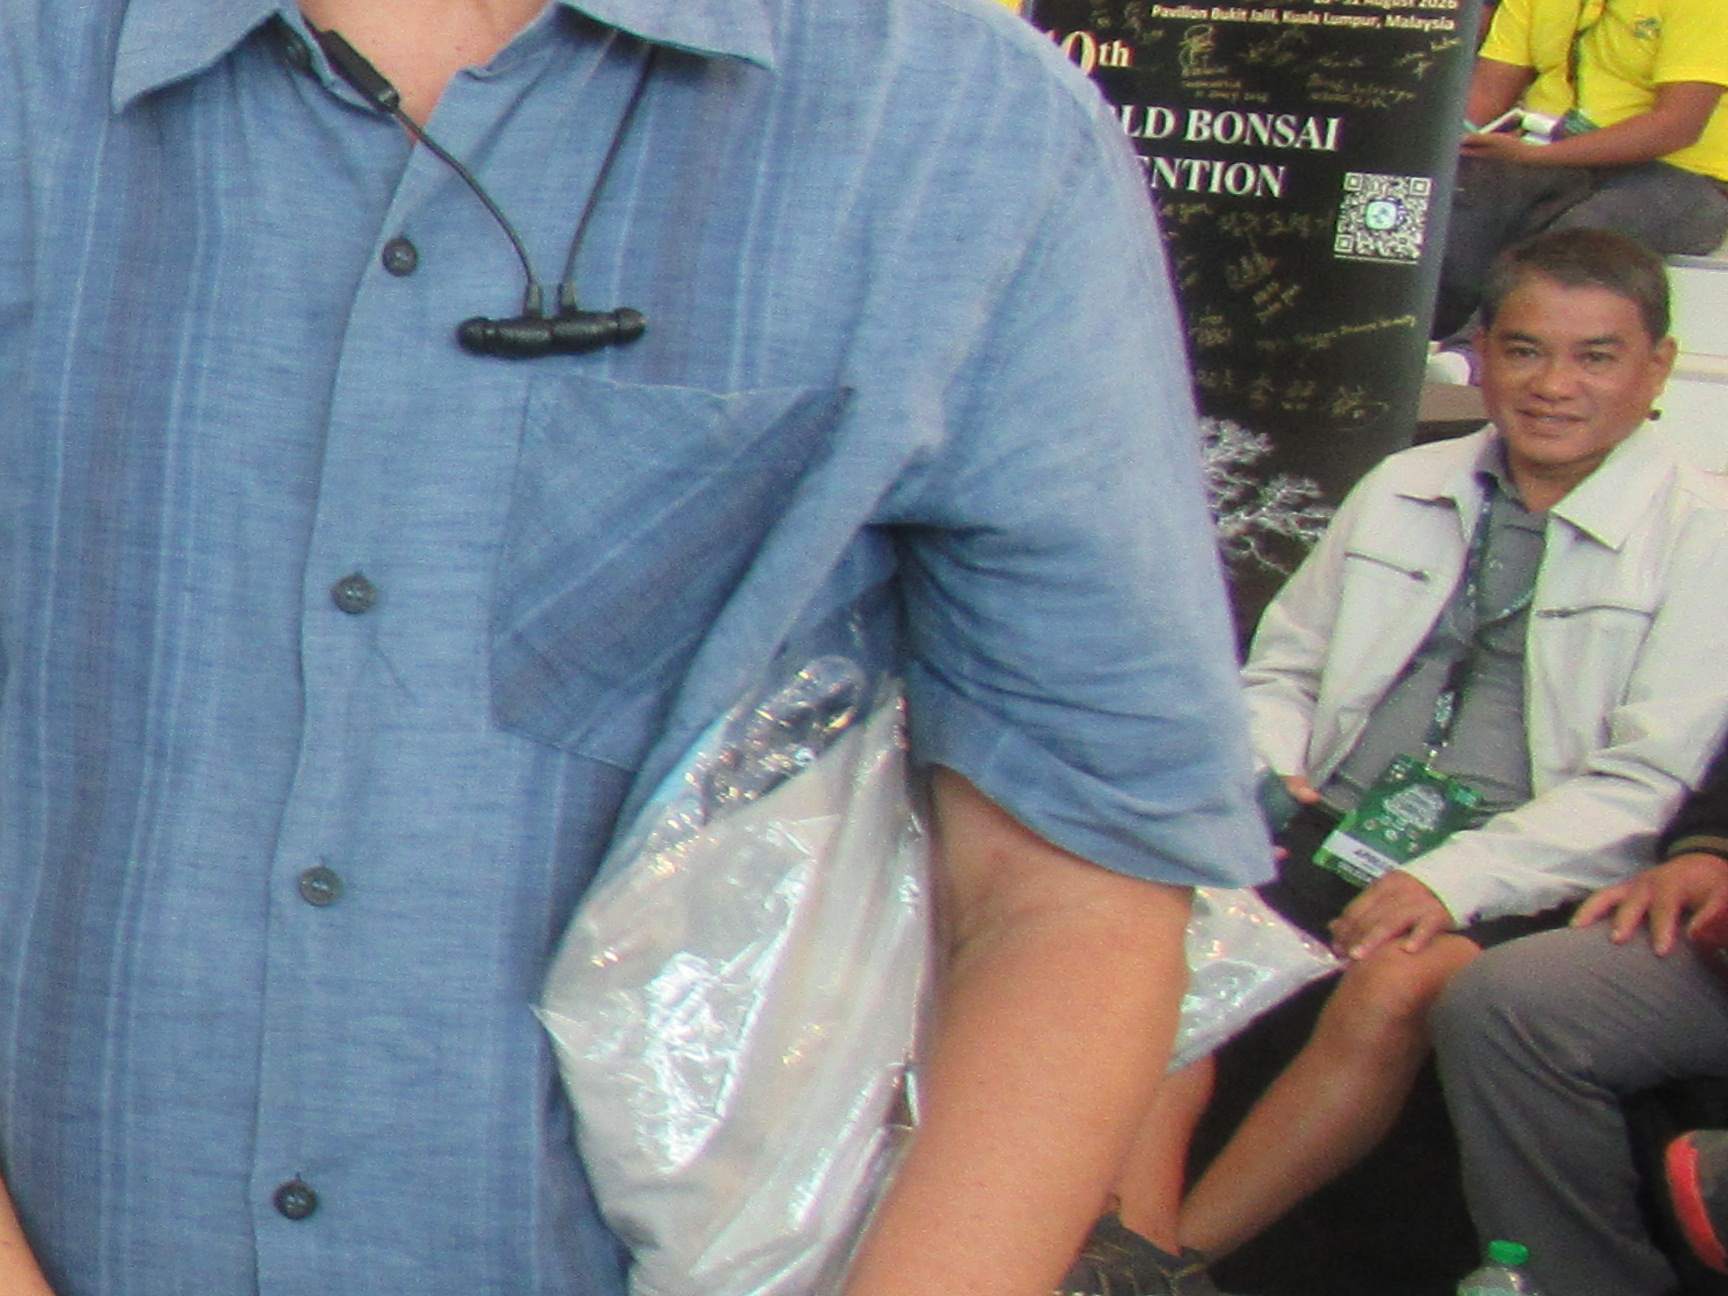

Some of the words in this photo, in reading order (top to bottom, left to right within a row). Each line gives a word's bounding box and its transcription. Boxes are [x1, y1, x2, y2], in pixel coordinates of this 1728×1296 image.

[1384, 14, 1455, 32] Malaysia
[1113, 103, 1176, 139] LD
[1184, 108, 1342, 152] BONSAI
[1138, 155, 1287, 199] NTION
